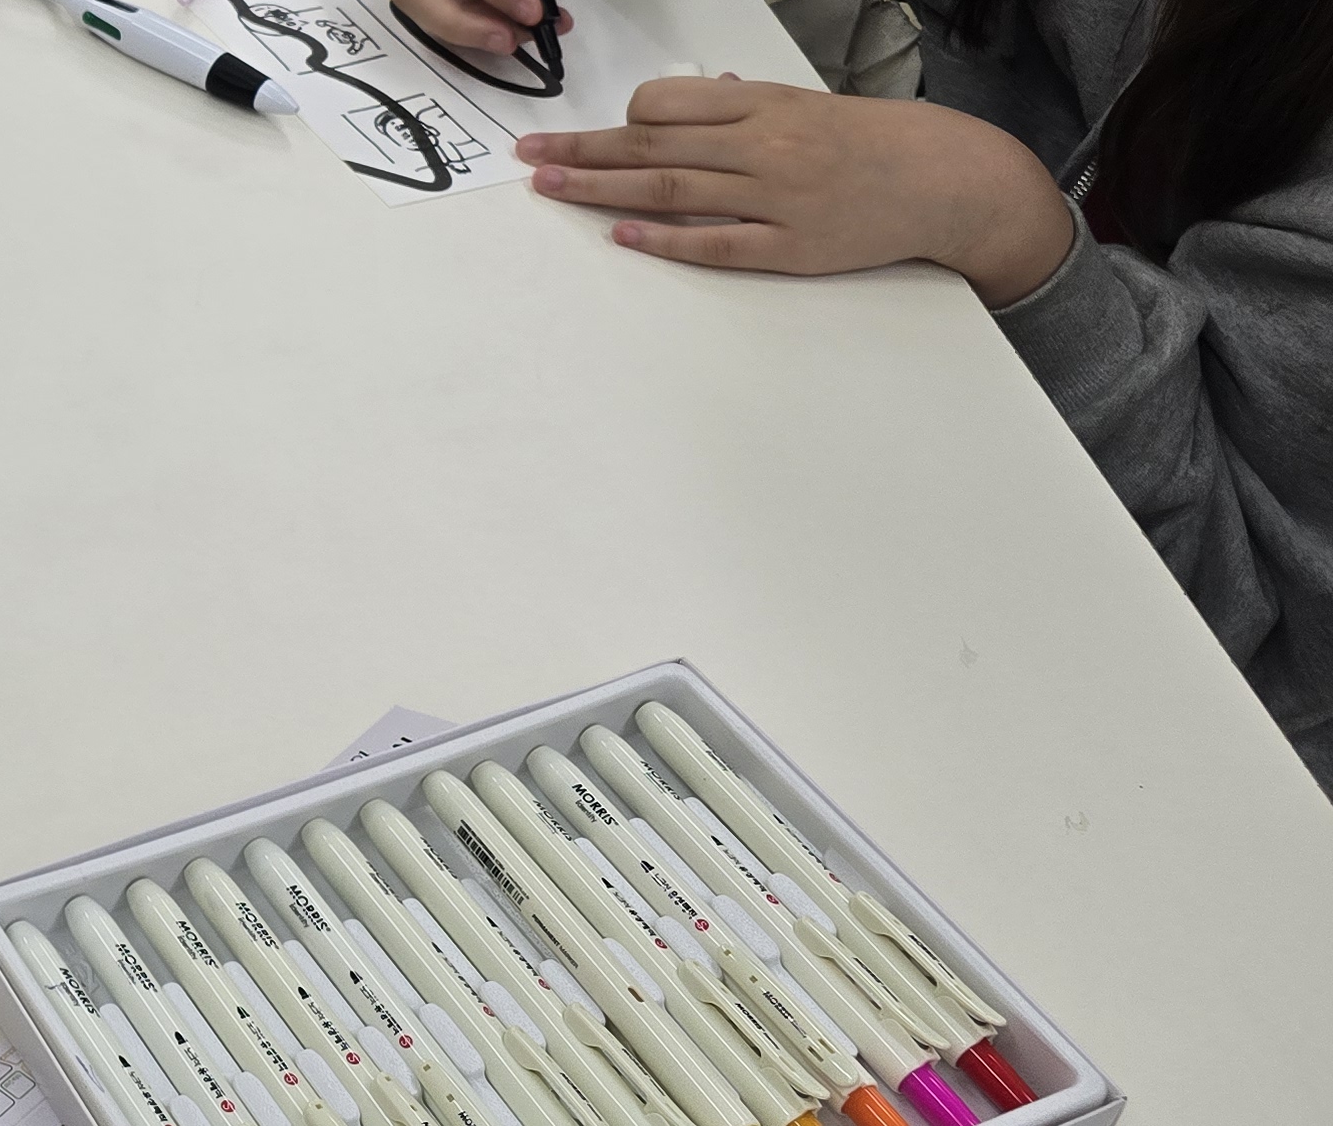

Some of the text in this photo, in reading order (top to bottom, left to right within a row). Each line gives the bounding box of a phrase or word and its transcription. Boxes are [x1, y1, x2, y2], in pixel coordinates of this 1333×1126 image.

[572, 782, 619, 826] MORRIS
[235, 901, 279, 949] MORRIS
[286, 884, 331, 932] MORRIS
[115, 943, 157, 992] MORRIS
[176, 920, 219, 969] MORRIS
[58, 967, 100, 1017] MORRIS
